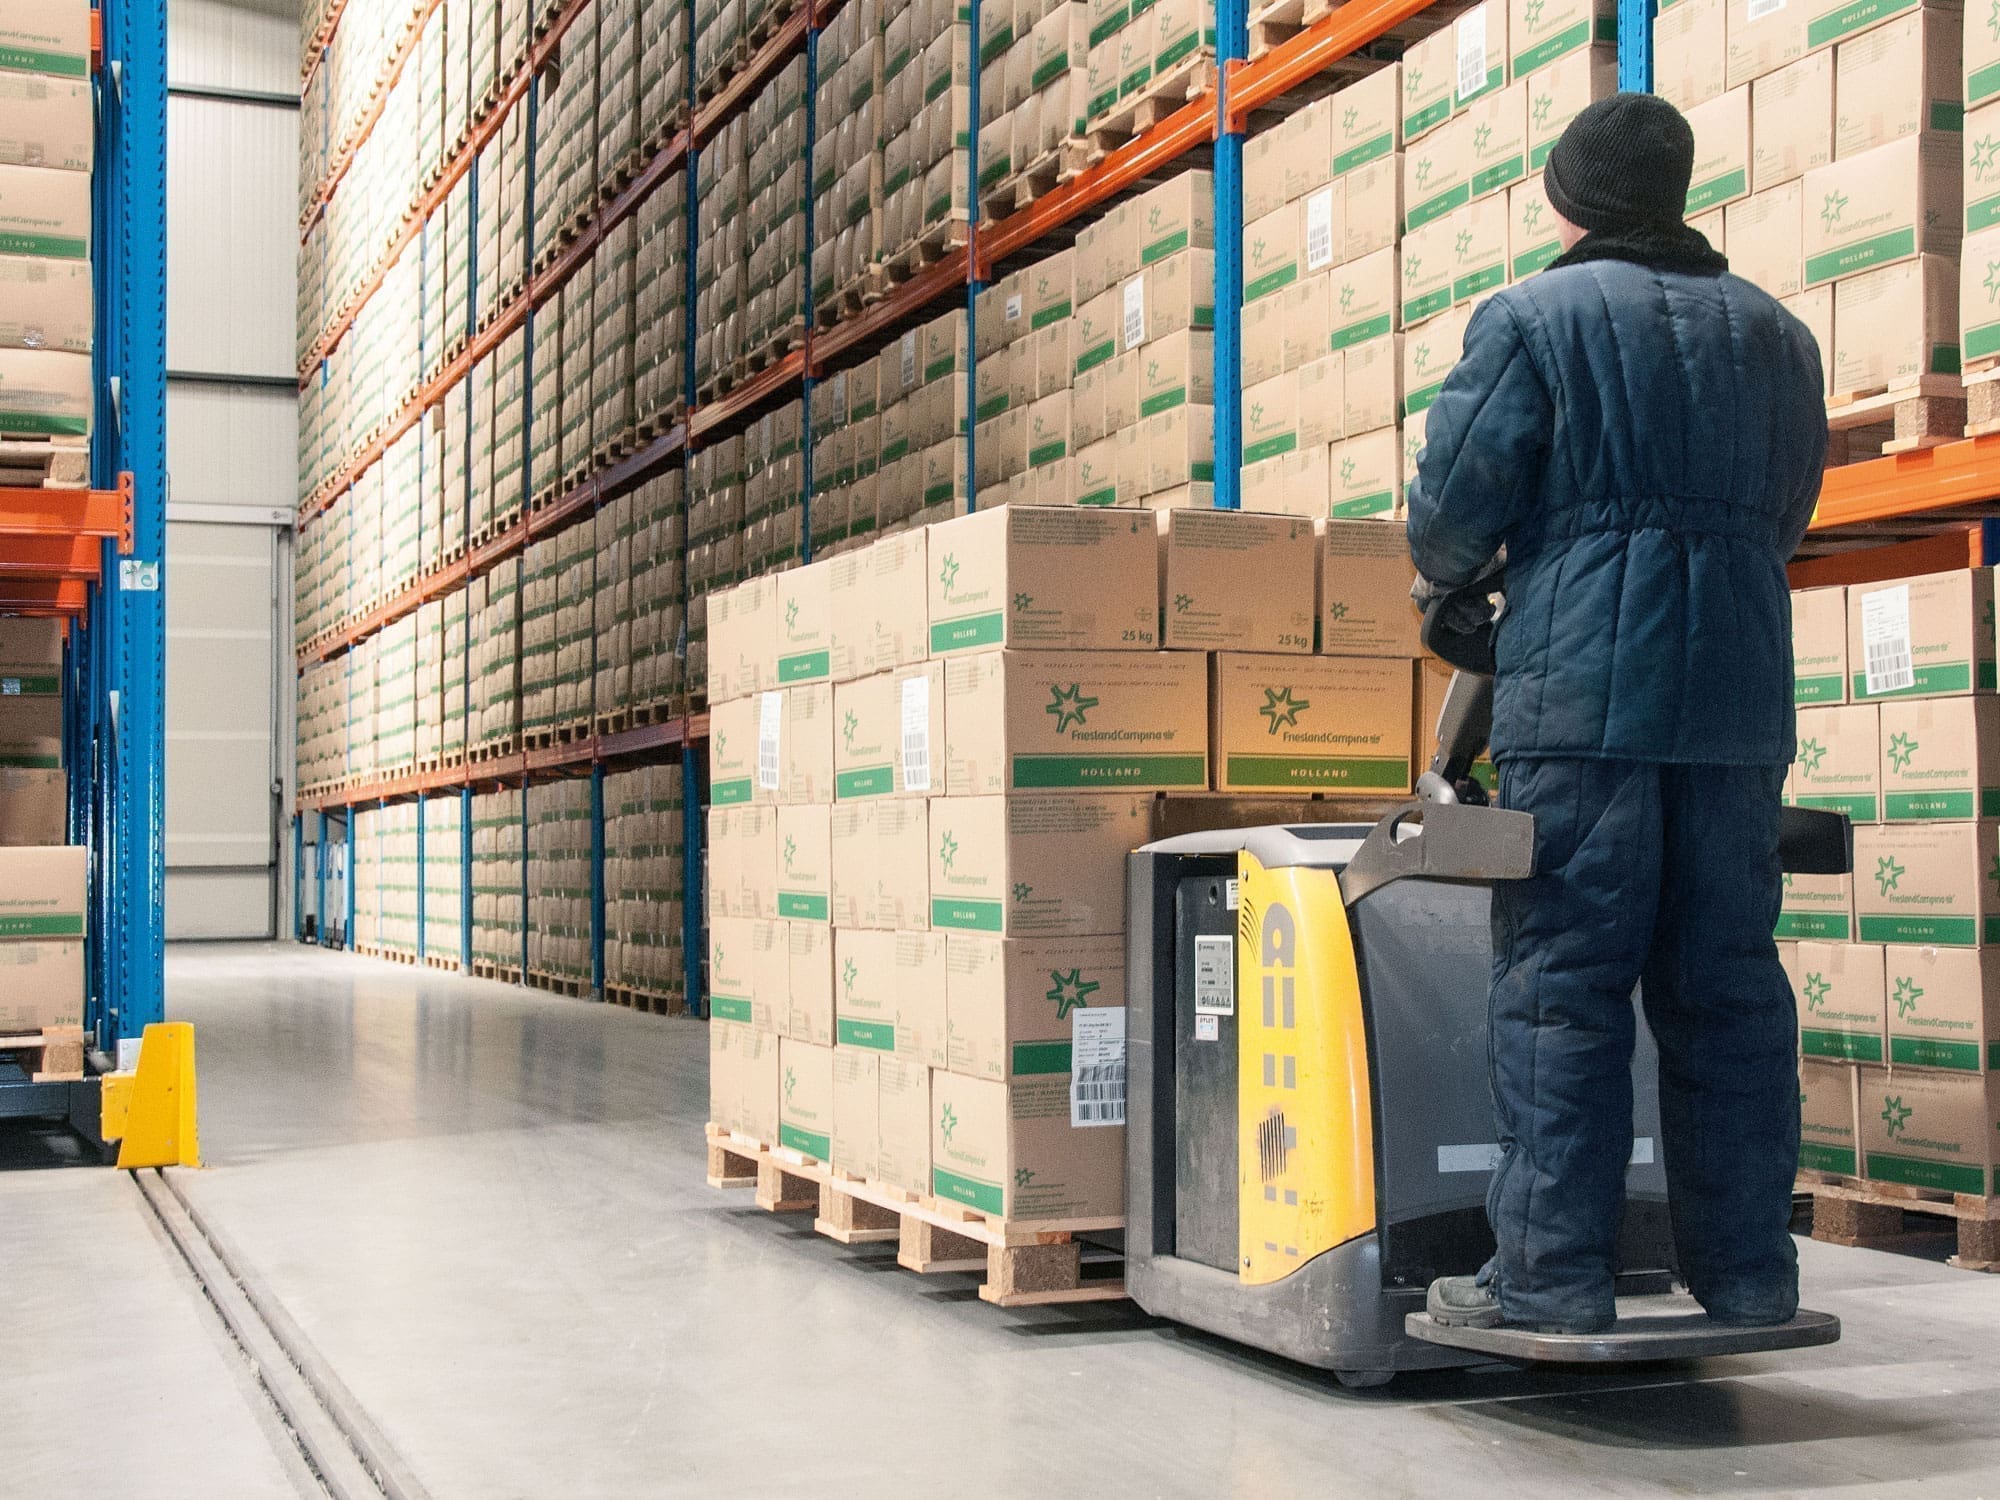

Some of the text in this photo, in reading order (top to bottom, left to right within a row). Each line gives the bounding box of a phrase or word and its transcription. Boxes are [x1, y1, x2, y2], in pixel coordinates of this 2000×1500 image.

[1842, 5, 1879, 25] HOLLAND
[1898, 121, 1918, 134] 25 kg
[64, 158, 88, 170] 25 kg
[1810, 152, 1827, 164] 25 kg
[1686, 189, 1713, 206] OLLAND
[1838, 249, 1875, 266] HOLLAND
[64, 338, 87, 348] 25 kg
[1897, 363, 1918, 375] 25 kg
[1122, 629, 1152, 643] 25 kg
[1278, 634, 1308, 649] 25 kg
[1071, 729, 1162, 744] FrieslandCampina
[1282, 730, 1370, 747] FrieslandCampina
[1080, 766, 1142, 778] HOLLAND
[1290, 768, 1349, 778] HOLLAND
[1810, 772, 1863, 785] FrieslandCampina
[1901, 768, 1958, 782] FrieslandCampina
[1908, 801, 1948, 811] HOLLAND
[1888, 893, 1946, 906] FrieslandCampina
[1790, 922, 1826, 930] HOLLAND
[1896, 926, 1936, 936] HOLLAND
[1906, 1015, 1965, 1031] FrieslandCampina
[1914, 1048, 1954, 1060] HOLLAND
